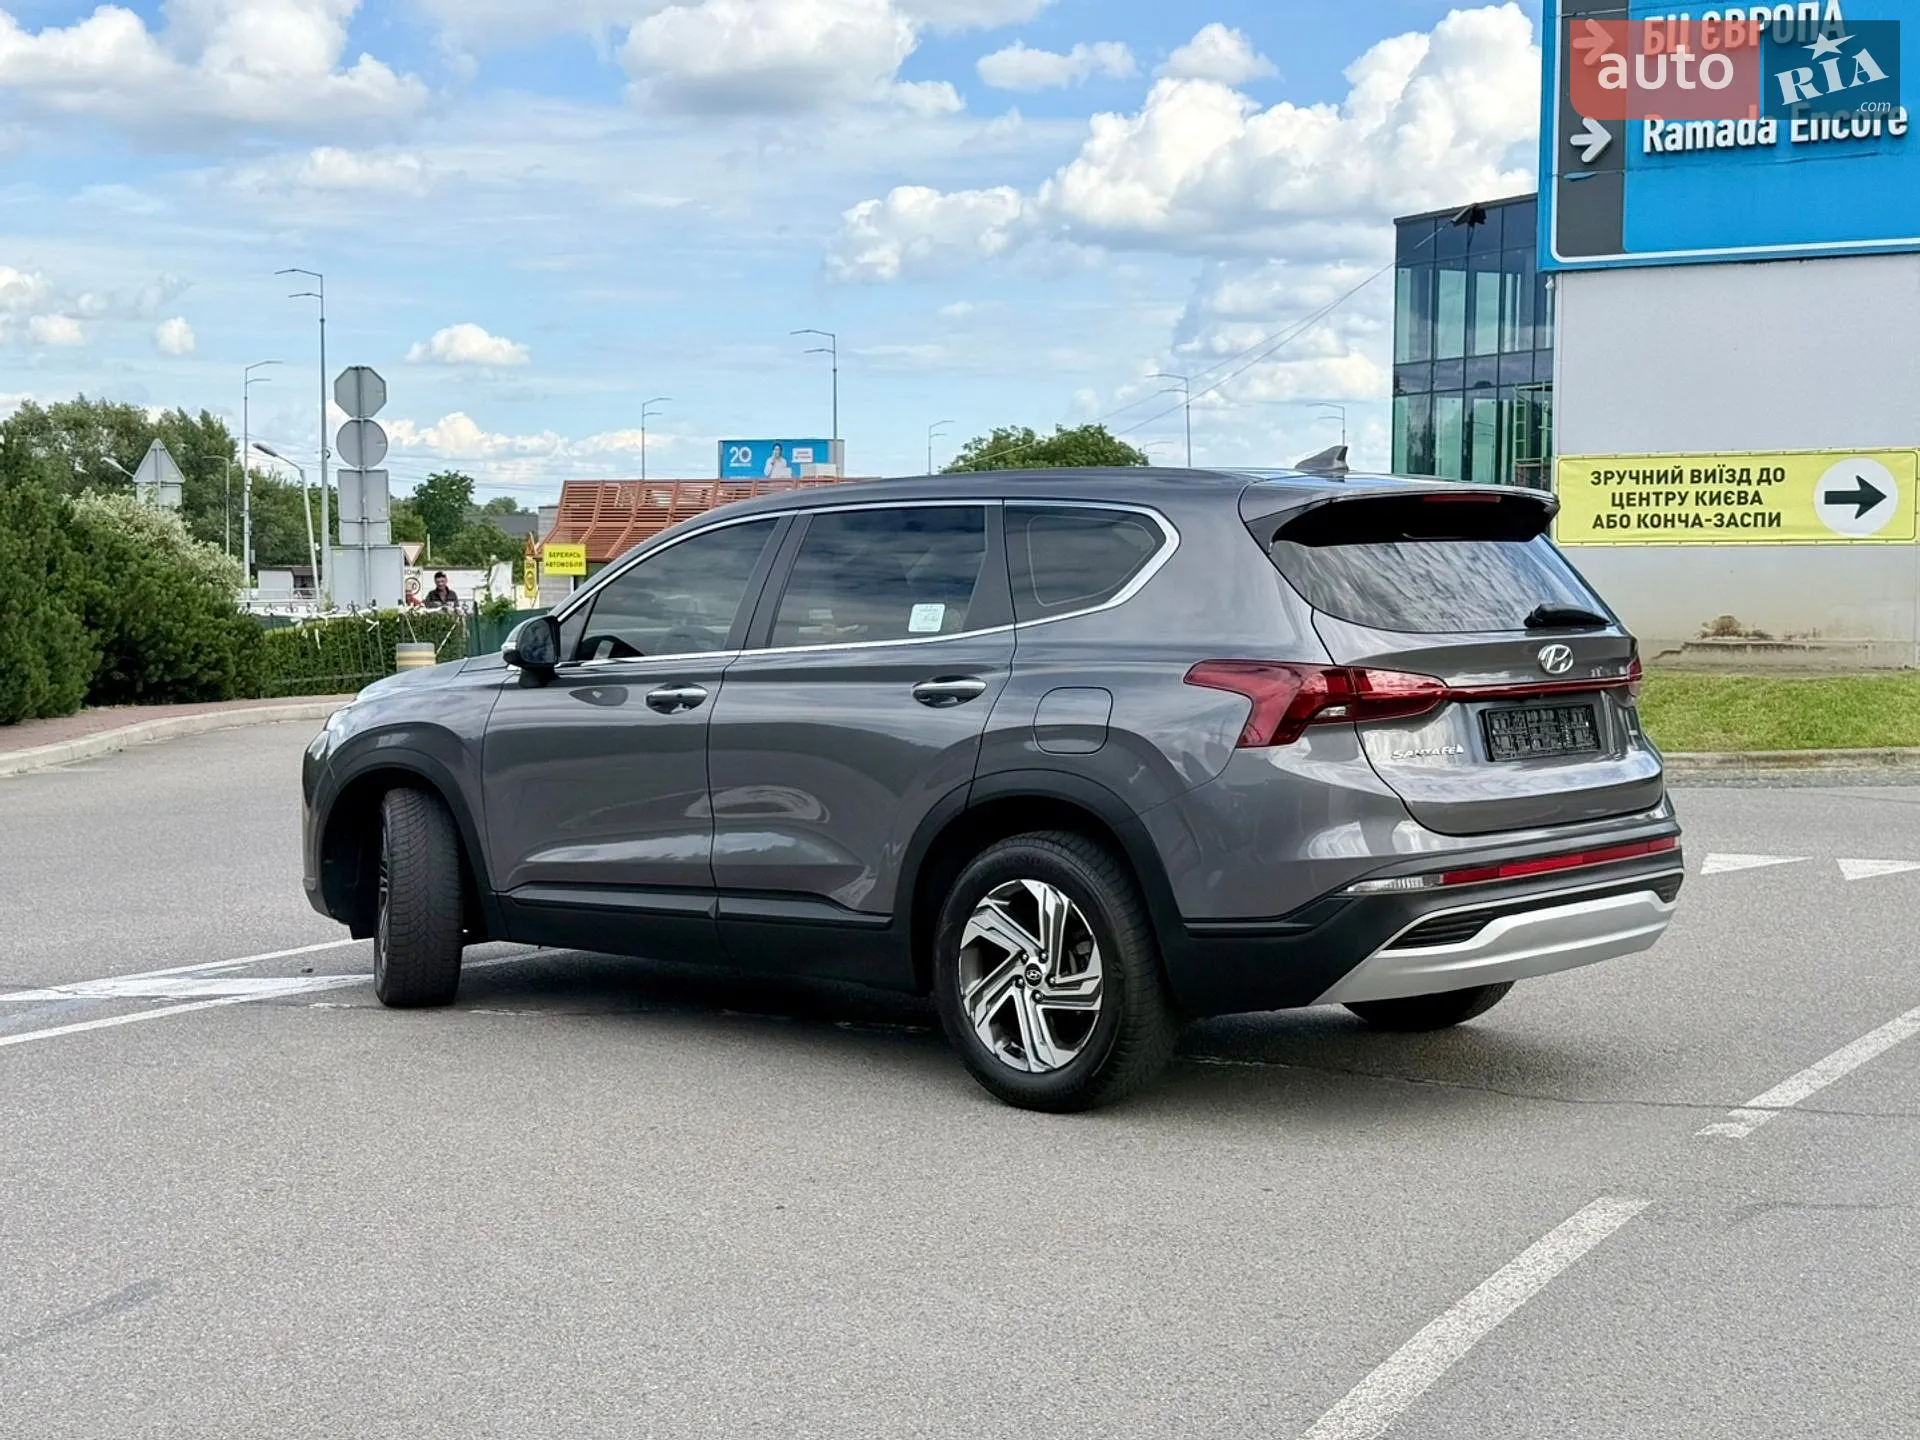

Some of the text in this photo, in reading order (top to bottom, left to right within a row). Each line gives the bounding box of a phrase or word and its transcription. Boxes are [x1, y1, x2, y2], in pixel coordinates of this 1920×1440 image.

[1643, 0, 1847, 55] БЦ ЄВРОПА
[1642, 103, 1908, 153] Ramada Encore
[729, 446, 752, 463] 20
[1590, 464, 1786, 486] ЗРУЧНИЙ ВИЇЗД ДО
[1611, 490, 1764, 510] ЦЕНТРУ КИЄВА
[1592, 512, 1782, 530] АБО КОНЧА-ЗАСПИ
